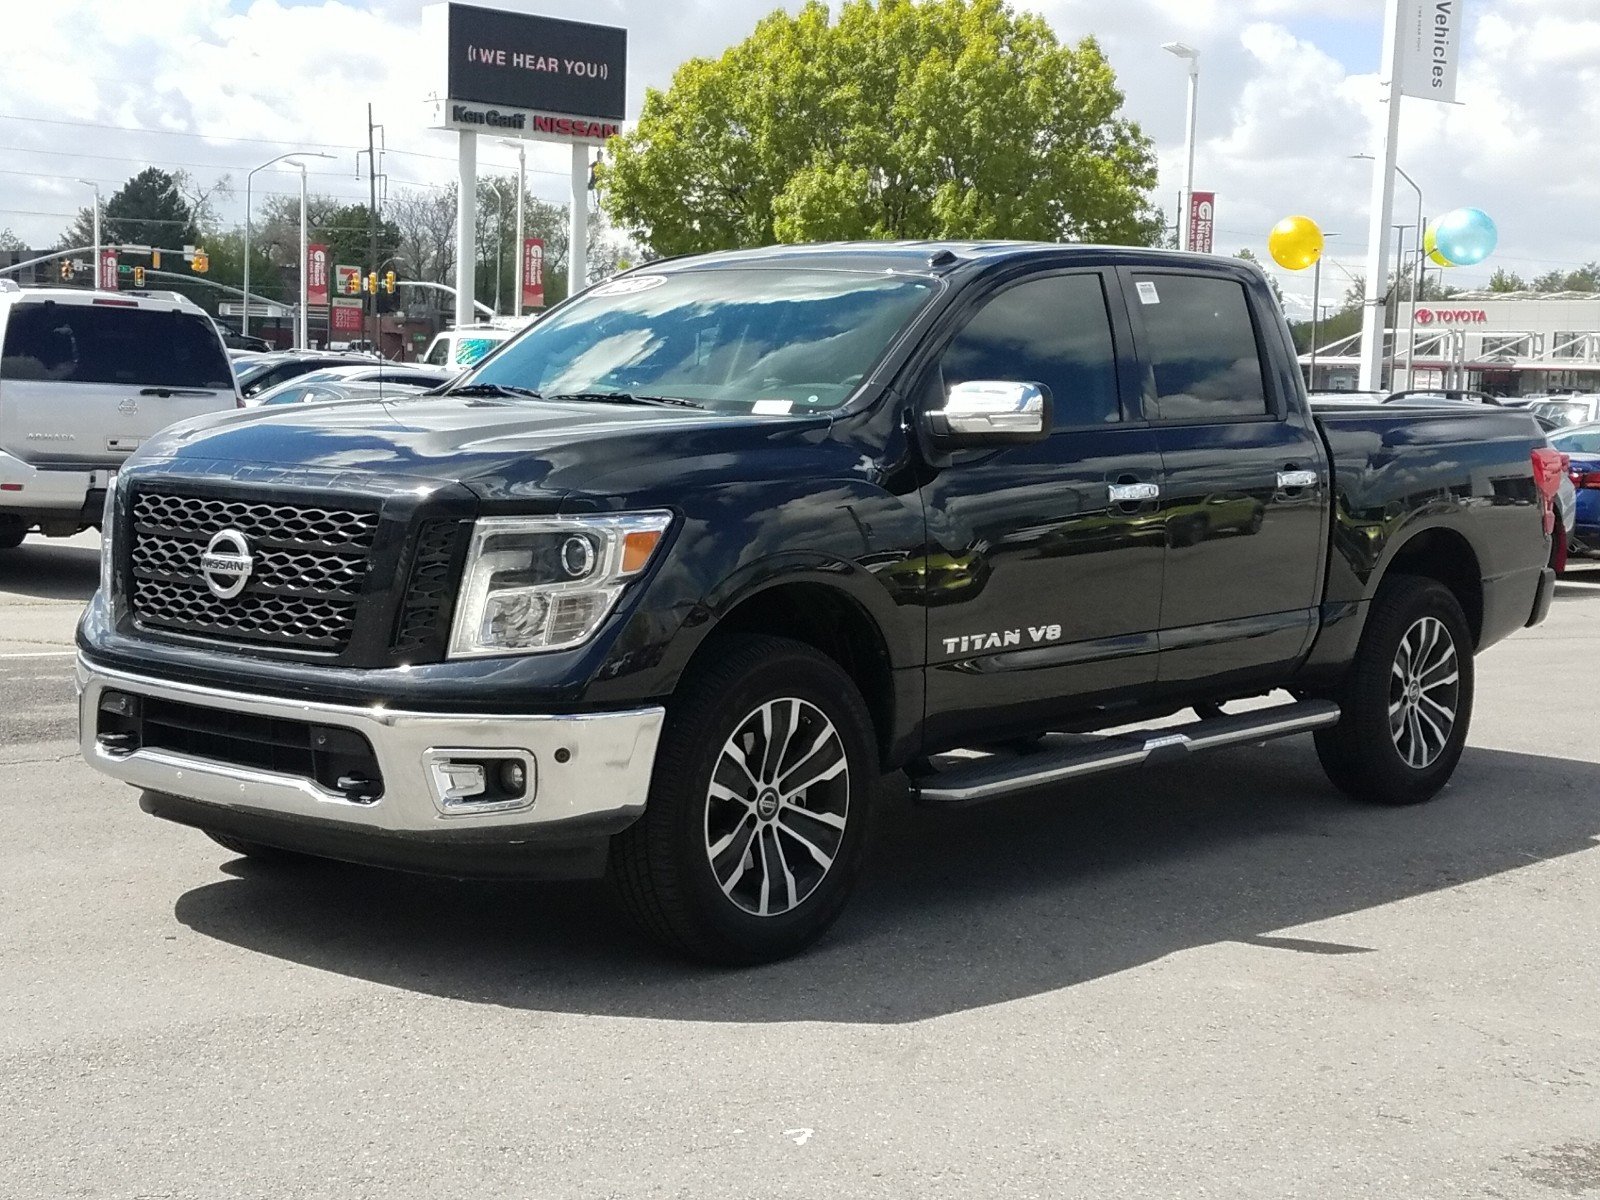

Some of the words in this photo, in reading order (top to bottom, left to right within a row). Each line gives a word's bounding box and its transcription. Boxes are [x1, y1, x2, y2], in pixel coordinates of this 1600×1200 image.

[1431, 2, 1452, 88] Vehicles
[480, 48, 506, 66] WE
[513, 52, 559, 73] HEAR
[564, 59, 598, 78] YOU
[452, 104, 485, 124] Ken
[533, 114, 619, 139] NISSAN
[1196, 221, 1205, 252] Nissa
[1203, 239, 1211, 252] Gar
[1435, 310, 1487, 323] TOYOTA
[201, 557, 245, 572] NISSAN
[942, 629, 1021, 654] TITAN
[1028, 624, 1062, 642] V8
